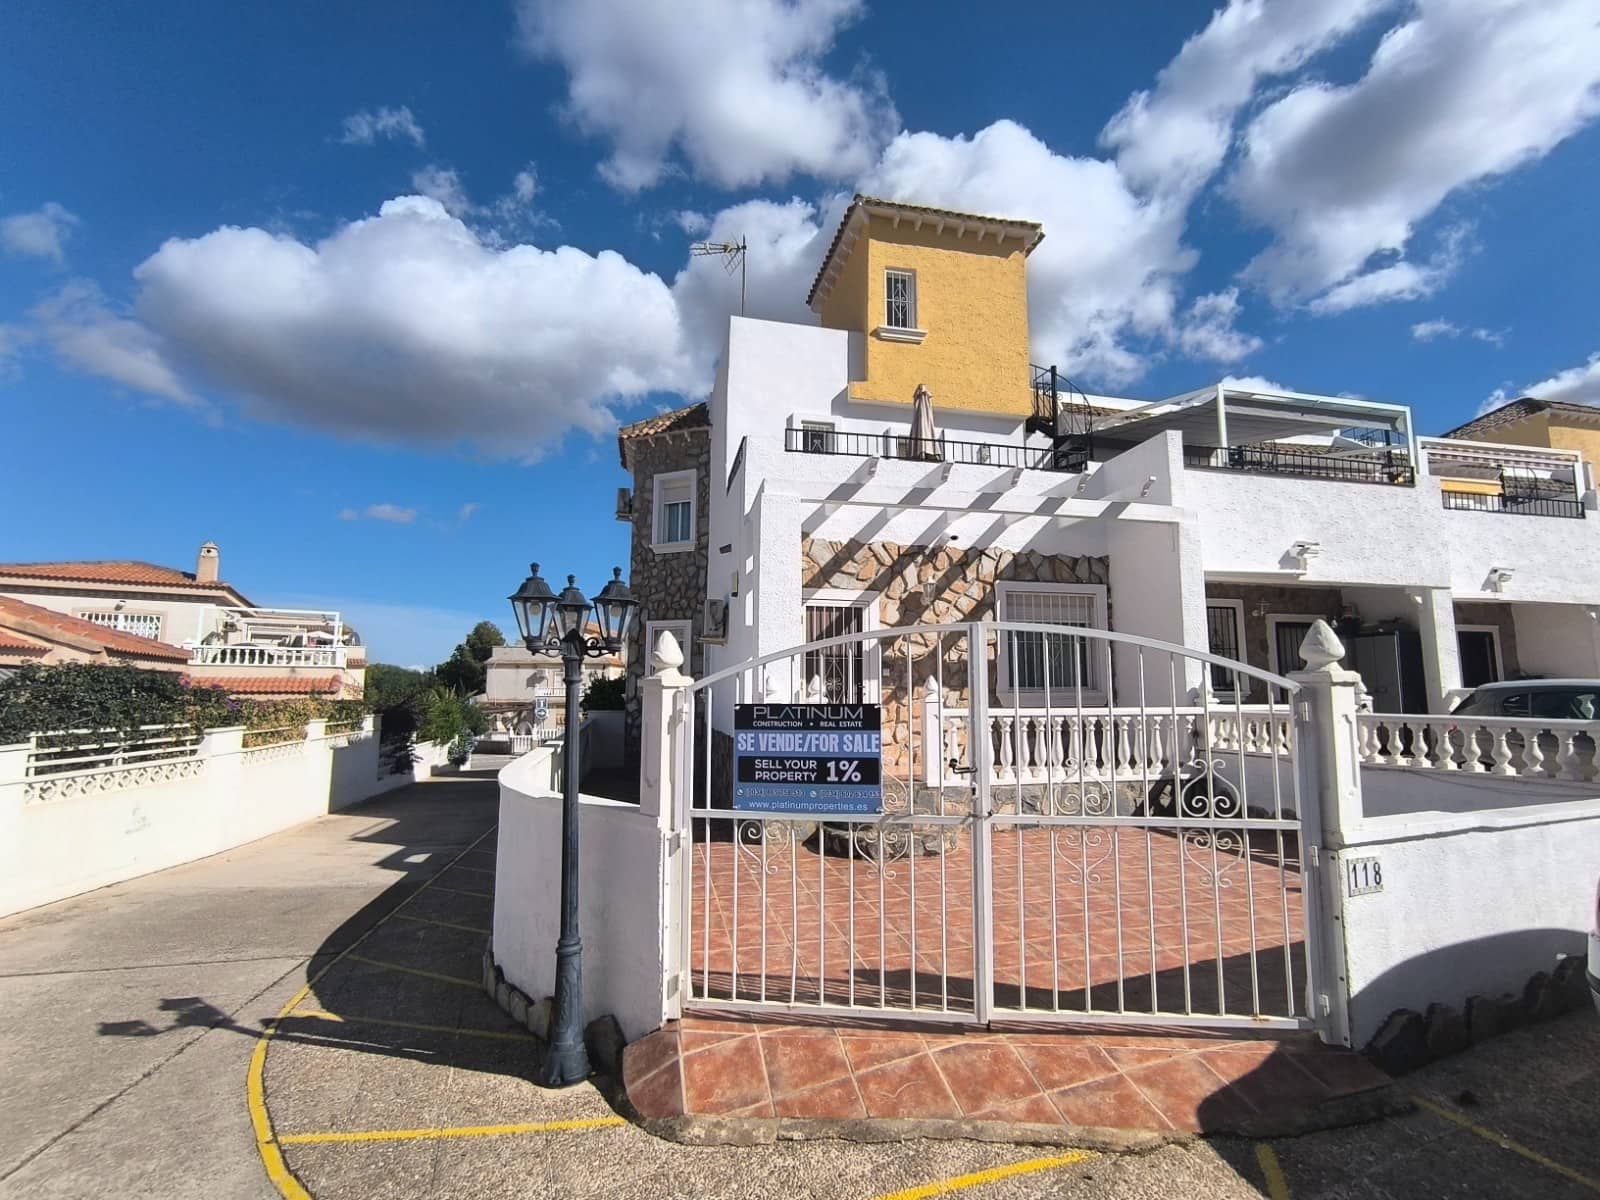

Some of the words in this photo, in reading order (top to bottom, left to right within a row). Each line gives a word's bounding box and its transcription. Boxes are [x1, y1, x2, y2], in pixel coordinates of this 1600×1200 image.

[753, 720, 803, 728] CONSTRUCTION
[820, 720, 836, 728] REAL
[737, 733, 755, 751] SE
[843, 734, 880, 753] SALE
[754, 759, 782, 770] SELL
[784, 759, 818, 770] YOUR
[755, 771, 818, 782] PROPERTY
[826, 760, 862, 782] 1%
[749, 800, 868, 812] www.platinumproperties.es
[1352, 861, 1382, 889] 118
